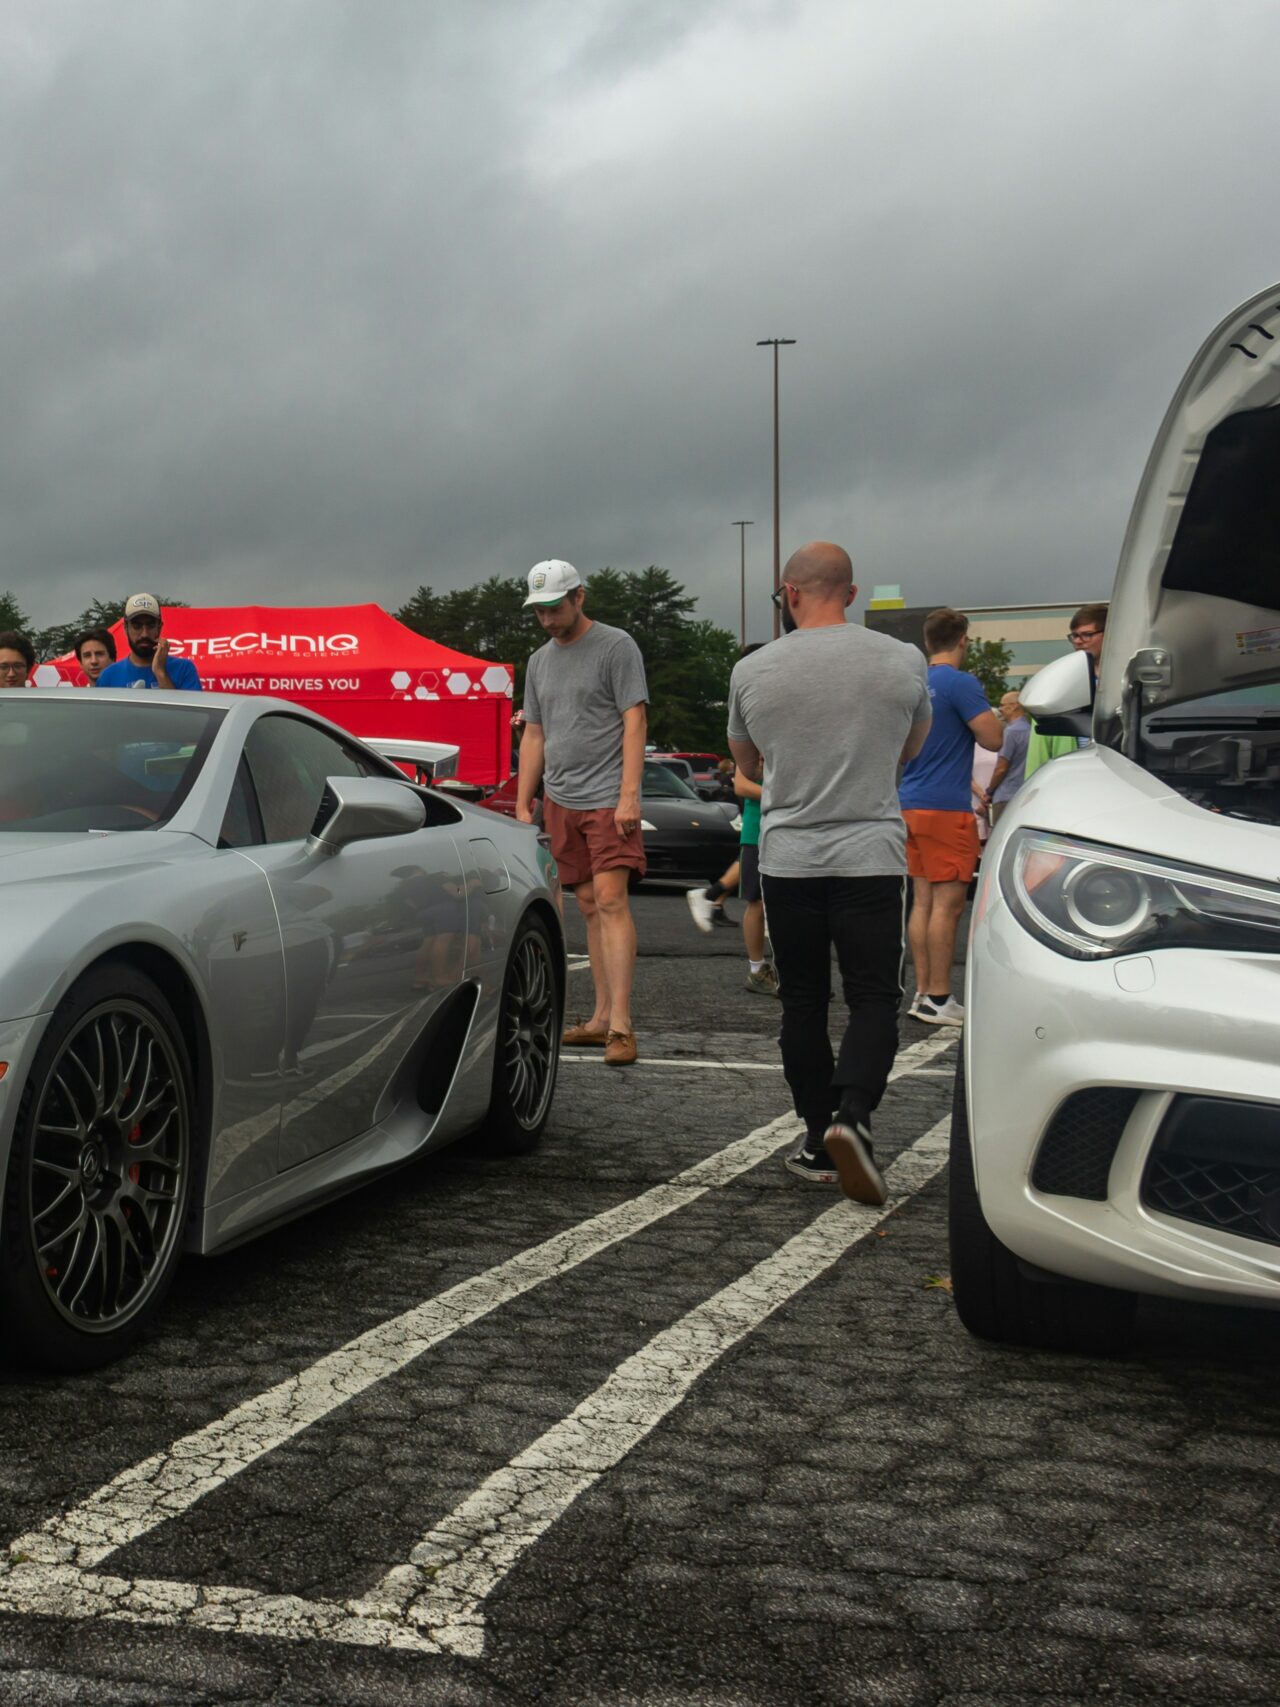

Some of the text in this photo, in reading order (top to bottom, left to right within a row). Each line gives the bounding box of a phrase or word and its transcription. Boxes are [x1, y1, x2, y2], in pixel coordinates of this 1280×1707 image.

[215, 648, 284, 659] SURFACE
[293, 649, 360, 657] SCIENCE
[220, 678, 265, 690] WHAT
[269, 678, 324, 690] DRIVES
[327, 678, 360, 690] YOU
